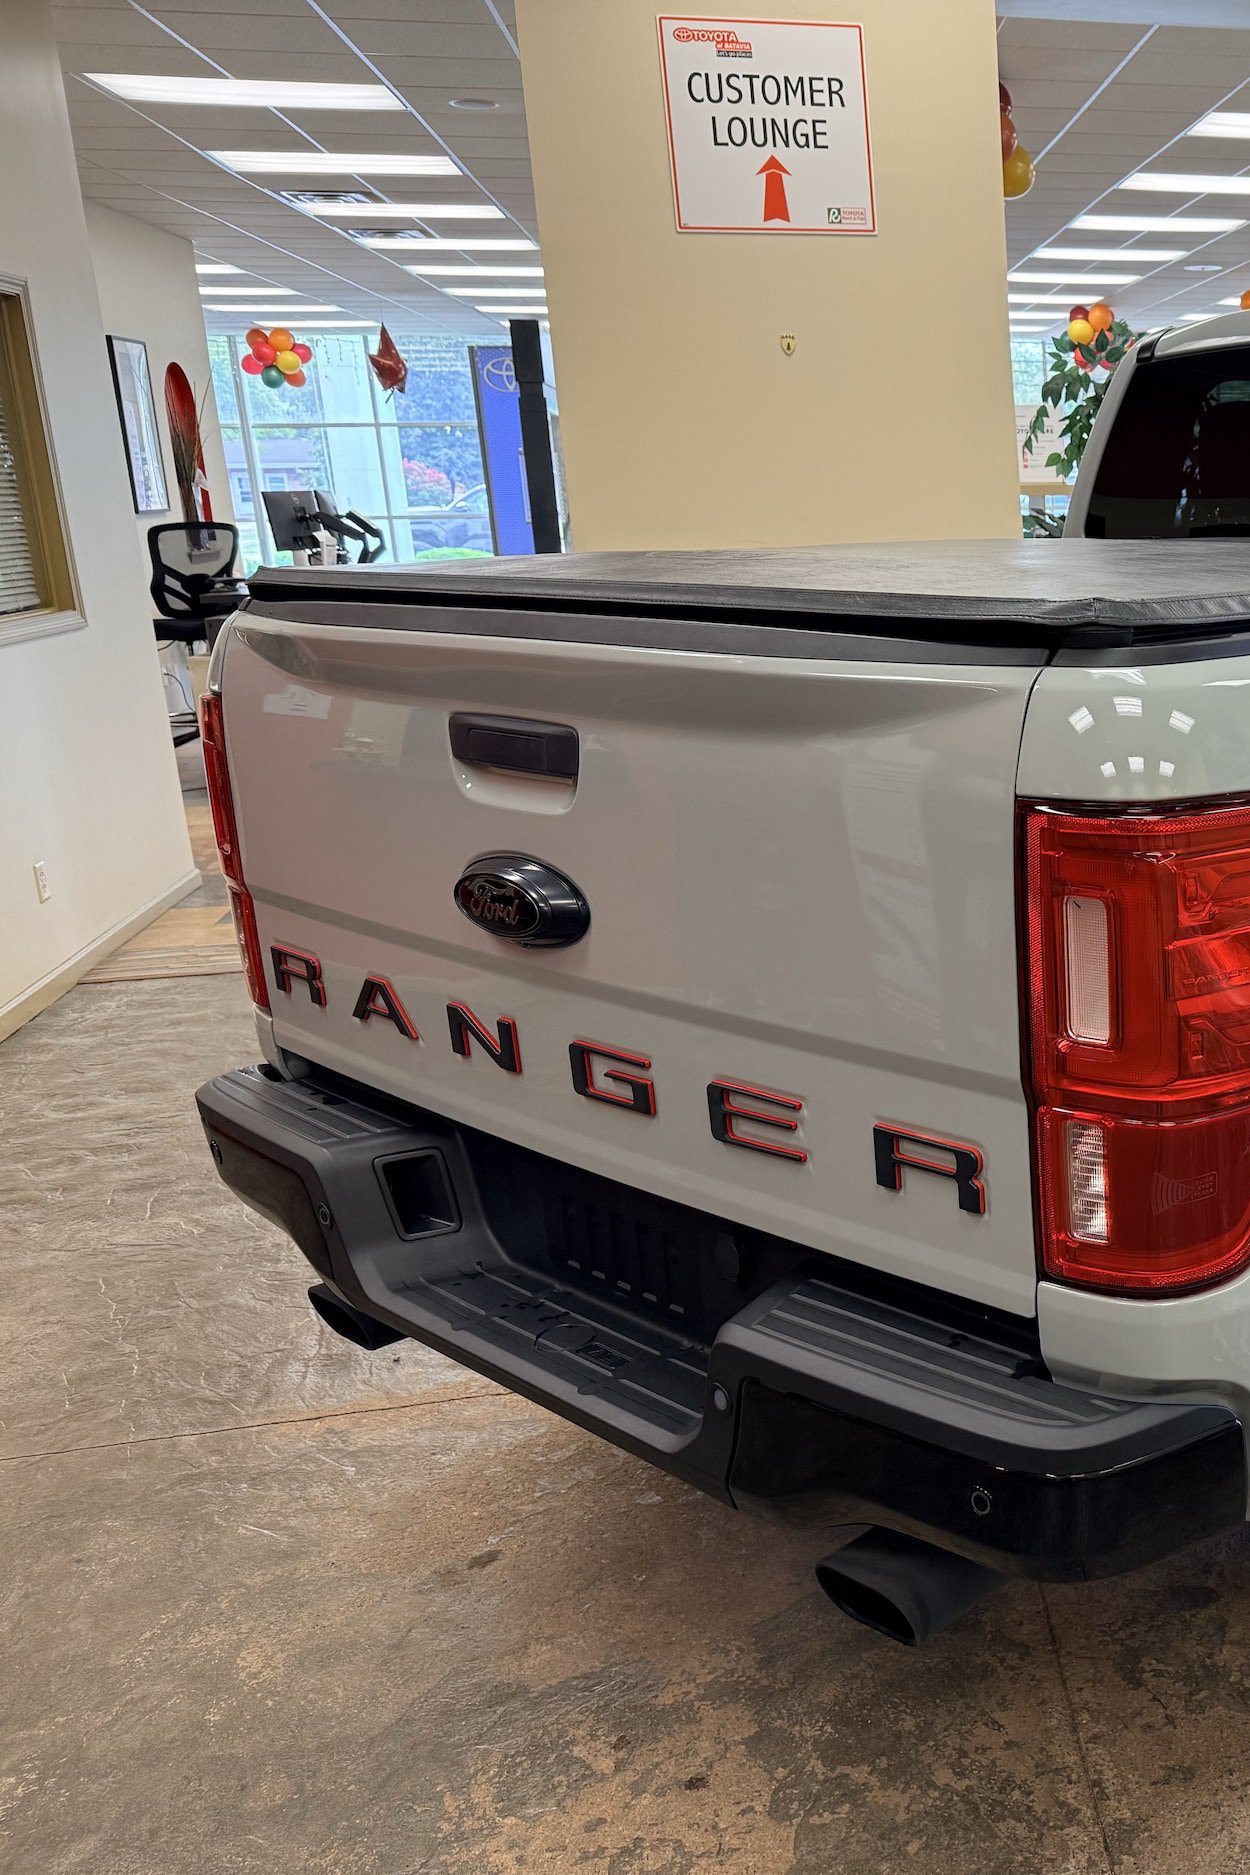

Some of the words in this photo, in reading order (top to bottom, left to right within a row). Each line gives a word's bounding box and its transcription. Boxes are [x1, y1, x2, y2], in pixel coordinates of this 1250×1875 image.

[692, 31, 738, 41] TOYOTA
[724, 42, 751, 50] BATAVIA
[687, 72, 845, 107] CUSTOMER
[711, 116, 829, 149] LOUNGE
[468, 878, 520, 926] Ford
[270, 944, 988, 1215] RANGER
